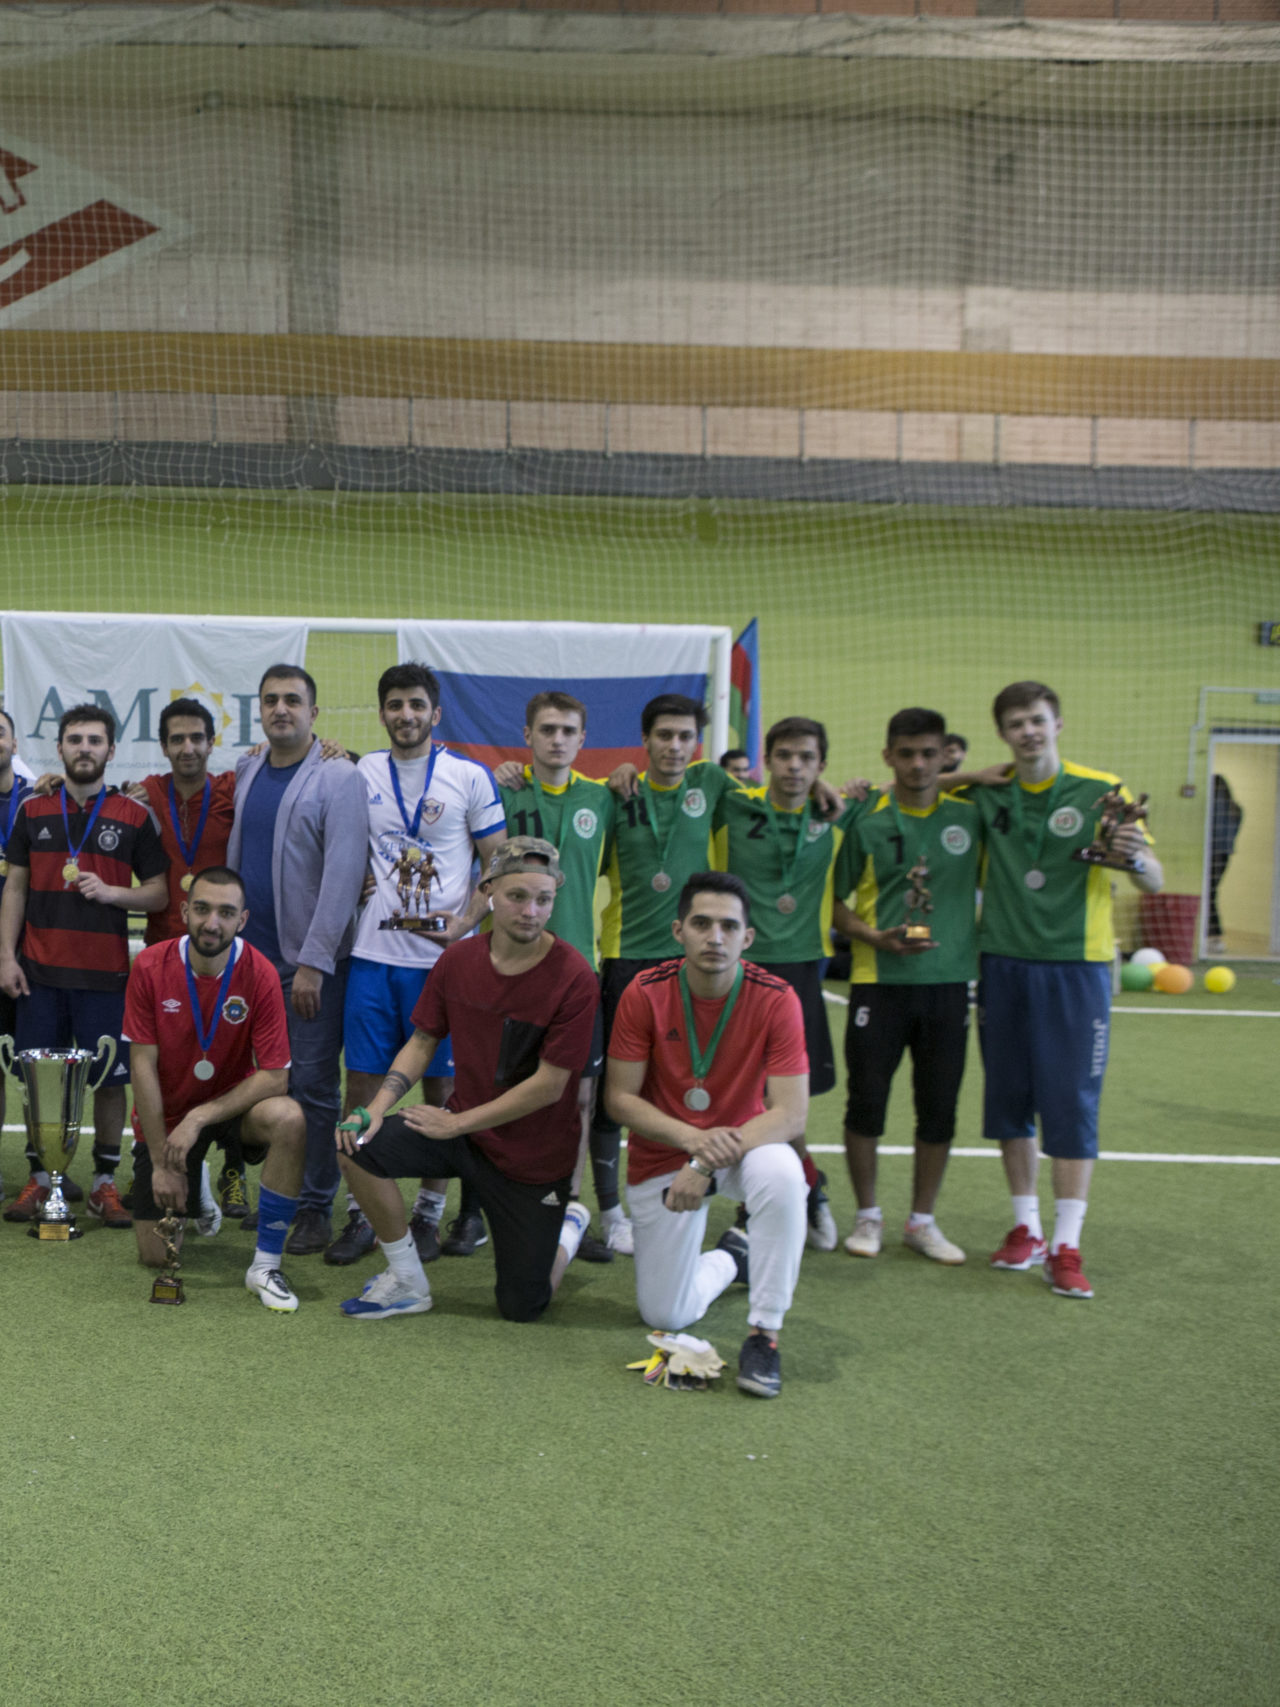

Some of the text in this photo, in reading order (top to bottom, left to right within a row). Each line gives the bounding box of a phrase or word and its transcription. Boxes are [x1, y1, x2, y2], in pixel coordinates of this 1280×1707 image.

[513, 809, 543, 838] 11
[747, 812, 768, 839] 2
[992, 806, 1010, 836] 4
[888, 835, 904, 865] 1
[855, 1006, 871, 1027] 6
